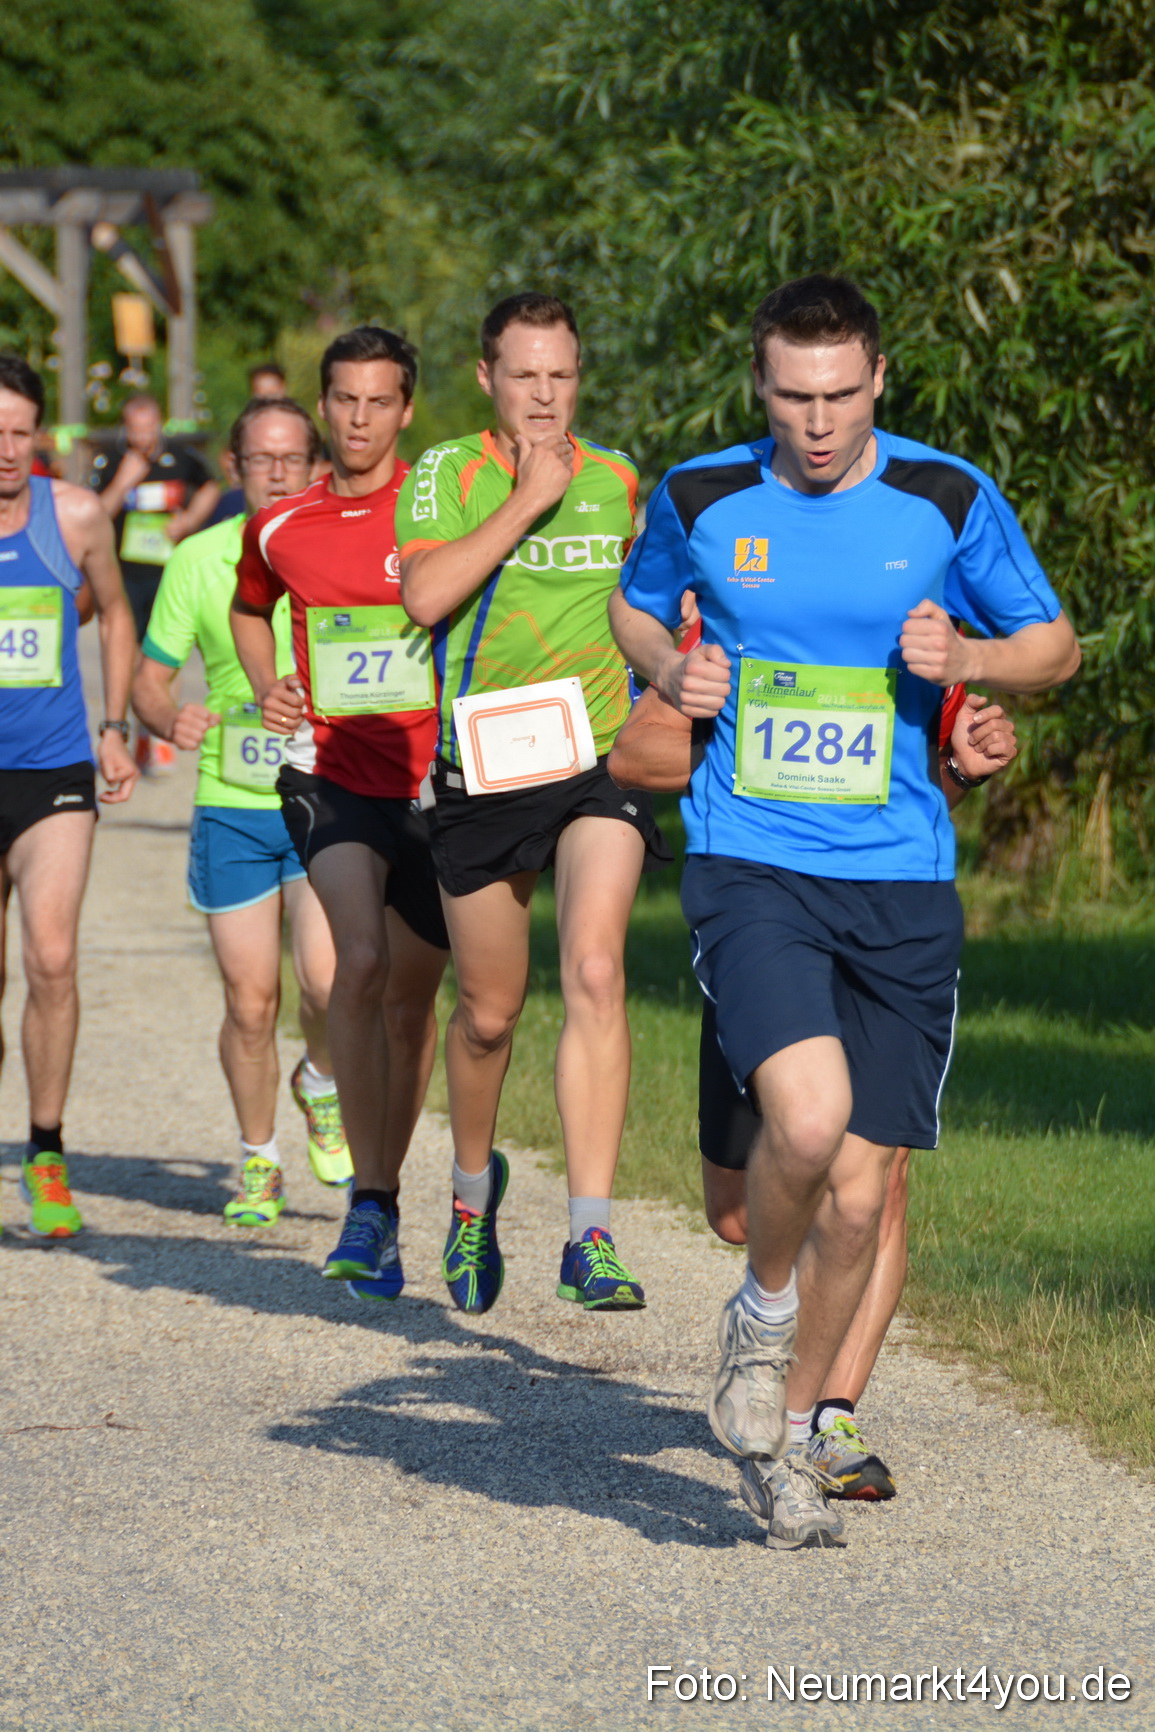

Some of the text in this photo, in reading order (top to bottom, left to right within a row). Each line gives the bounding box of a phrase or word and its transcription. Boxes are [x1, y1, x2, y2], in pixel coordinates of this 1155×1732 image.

[500, 535, 624, 572] OCK
[346, 650, 393, 685] 27
[763, 683, 817, 697] firmenlauf
[754, 717, 877, 766] 1284
[777, 771, 846, 784] Dominik Saake
